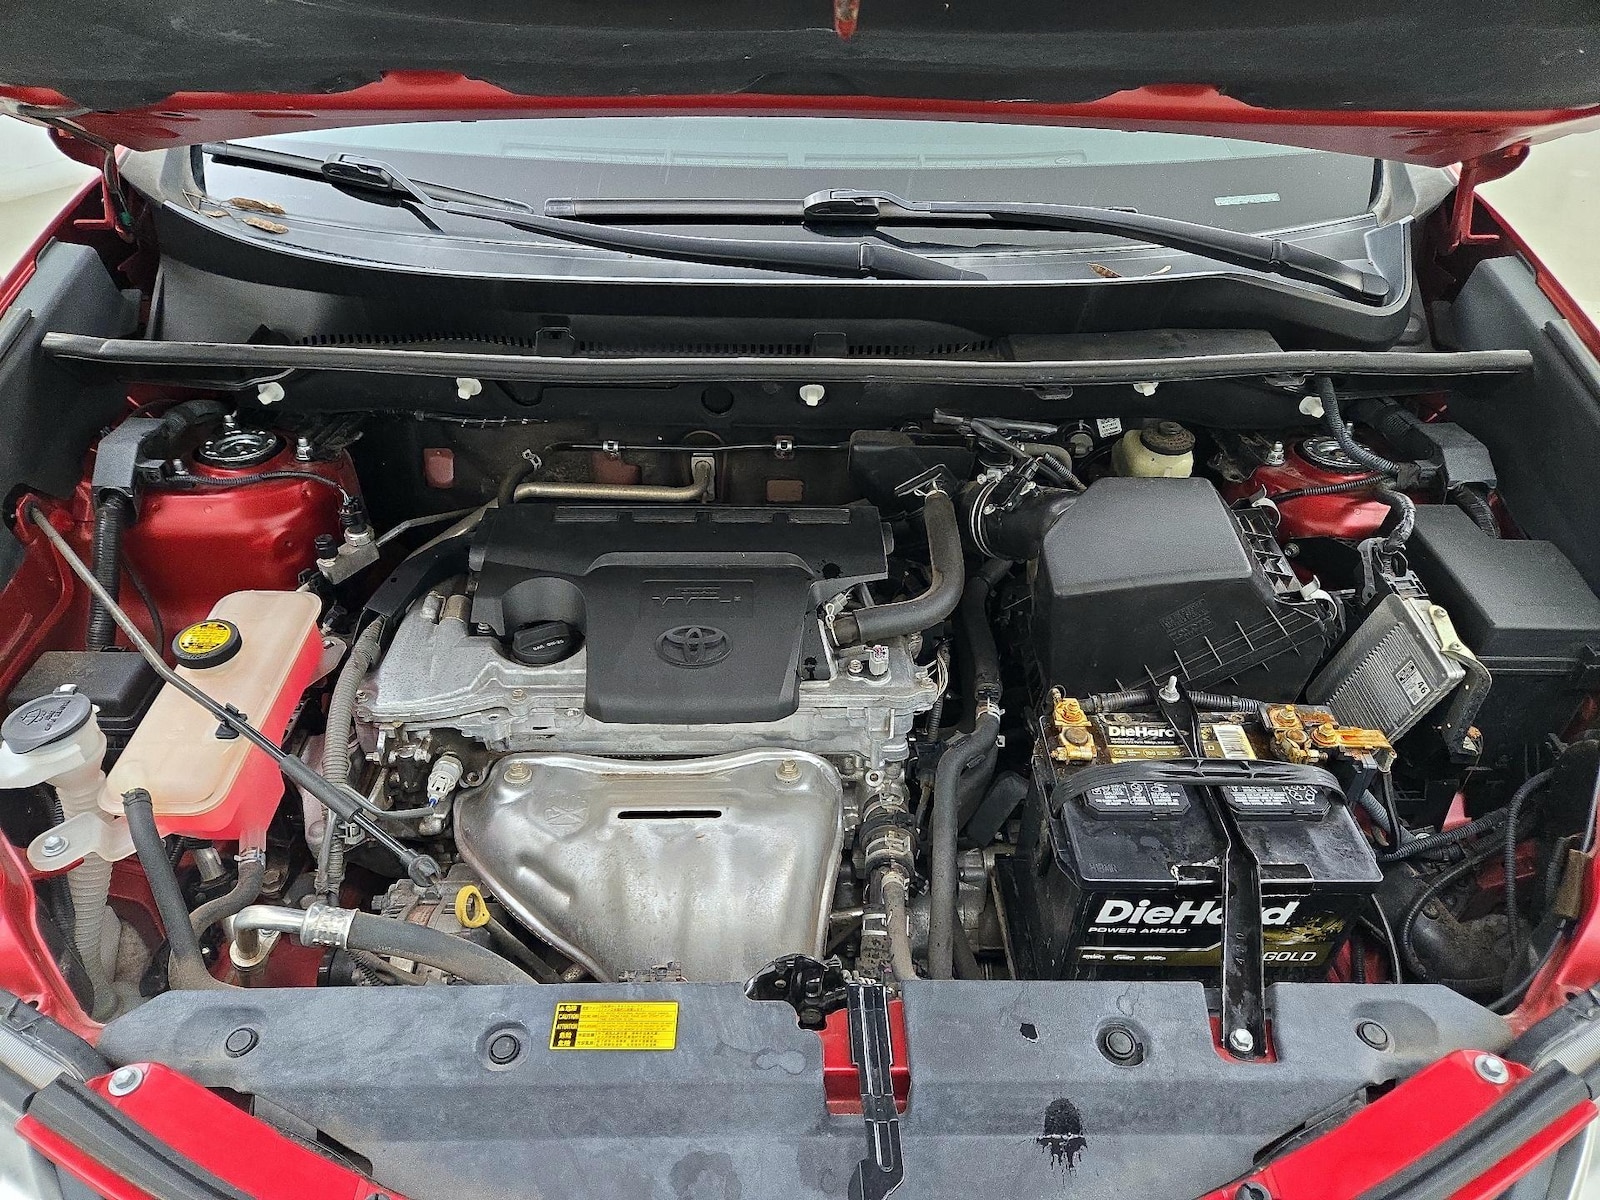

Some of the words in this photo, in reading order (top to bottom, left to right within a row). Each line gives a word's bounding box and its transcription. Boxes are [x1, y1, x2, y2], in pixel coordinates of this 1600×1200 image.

[1095, 899, 1300, 925] DieHad
[1088, 926, 1137, 934] POWER
[1139, 926, 1191, 934] AHEAD
[1262, 951, 1317, 961] GOLD
